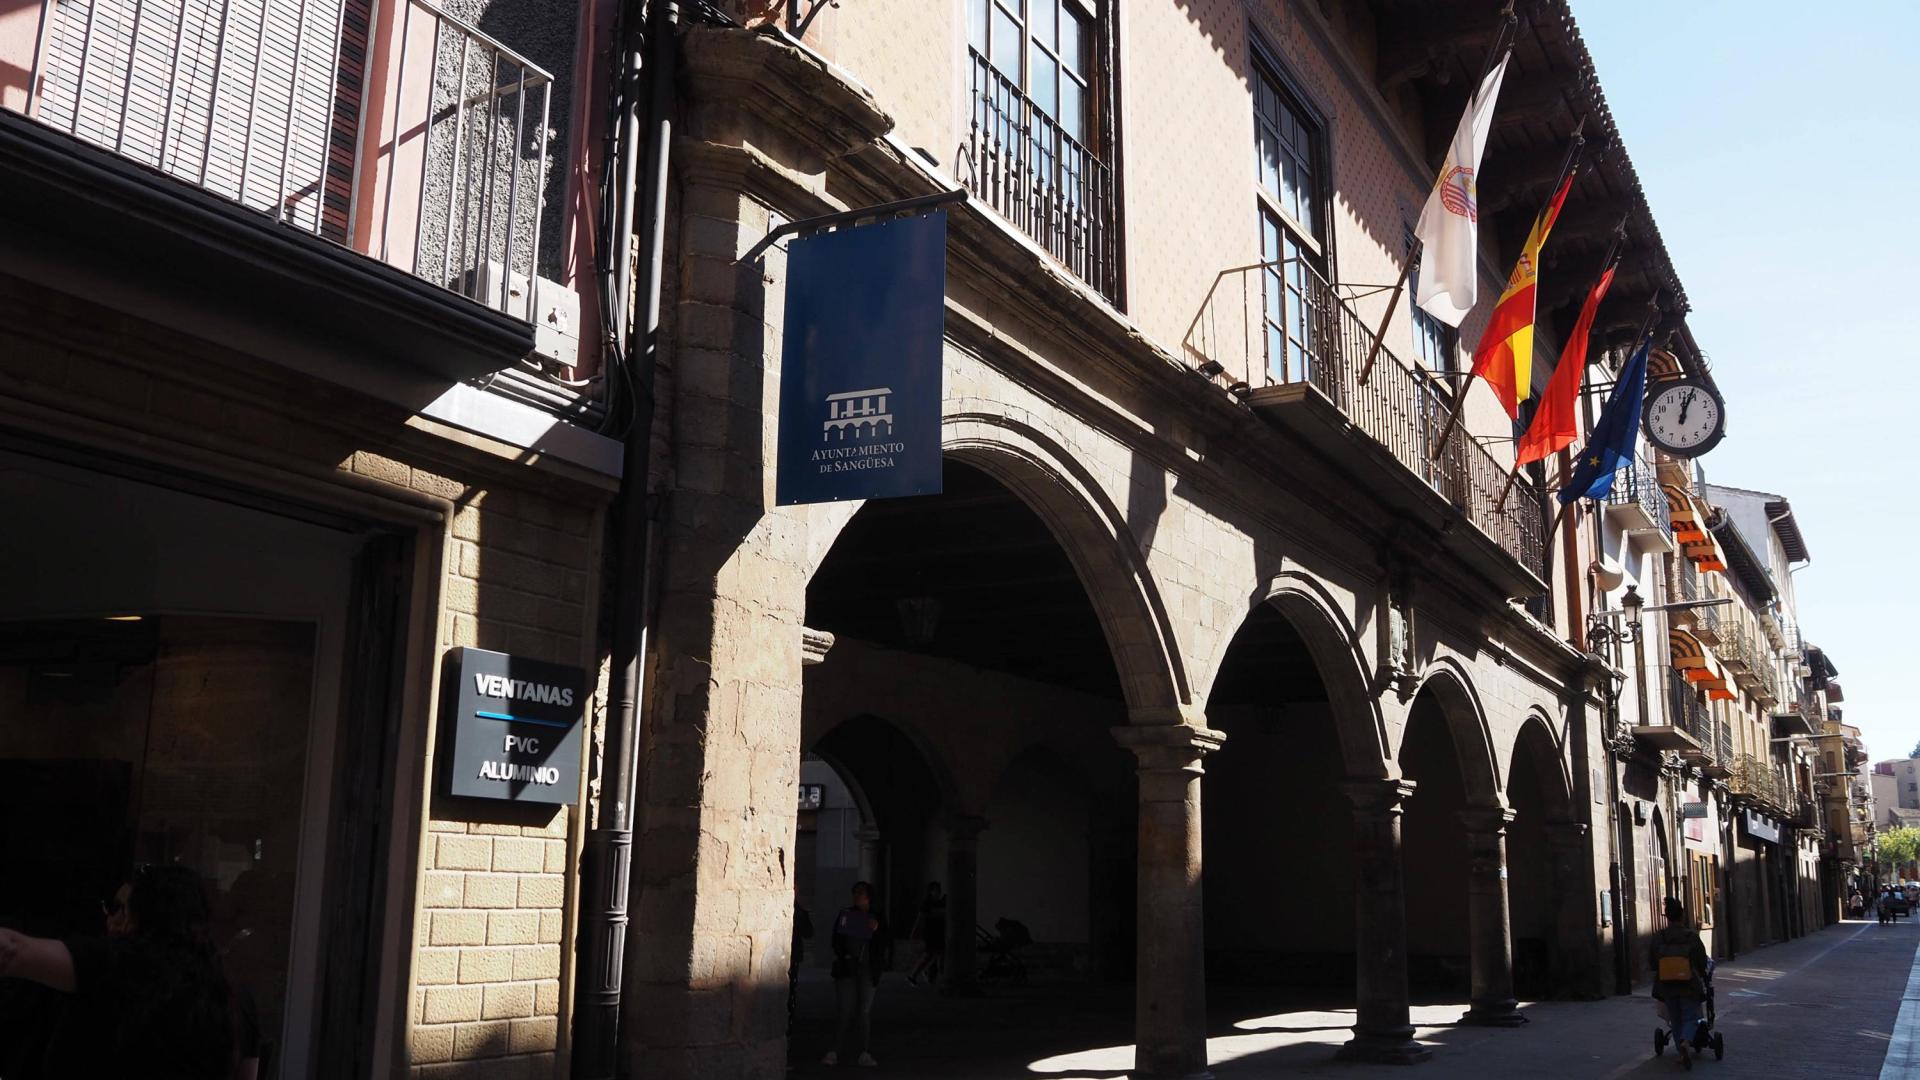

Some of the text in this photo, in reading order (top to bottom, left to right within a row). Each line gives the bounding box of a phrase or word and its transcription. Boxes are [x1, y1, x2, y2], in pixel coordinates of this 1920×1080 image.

[1666, 396, 1674, 404] 11
[1702, 400, 1708, 408] 2
[1658, 405, 1666, 413] 10
[1654, 415, 1660, 423] 9
[1706, 411, 1712, 419] 3
[1702, 422, 1707, 430] 4
[1668, 433, 1674, 441] 7
[1694, 431, 1699, 439] 5
[820, 457, 895, 473] DE SANGÜESA
[475, 672, 574, 707] VENTANAS
[504, 735, 539, 754] PVC
[478, 760, 560, 784] ALUMINIO
